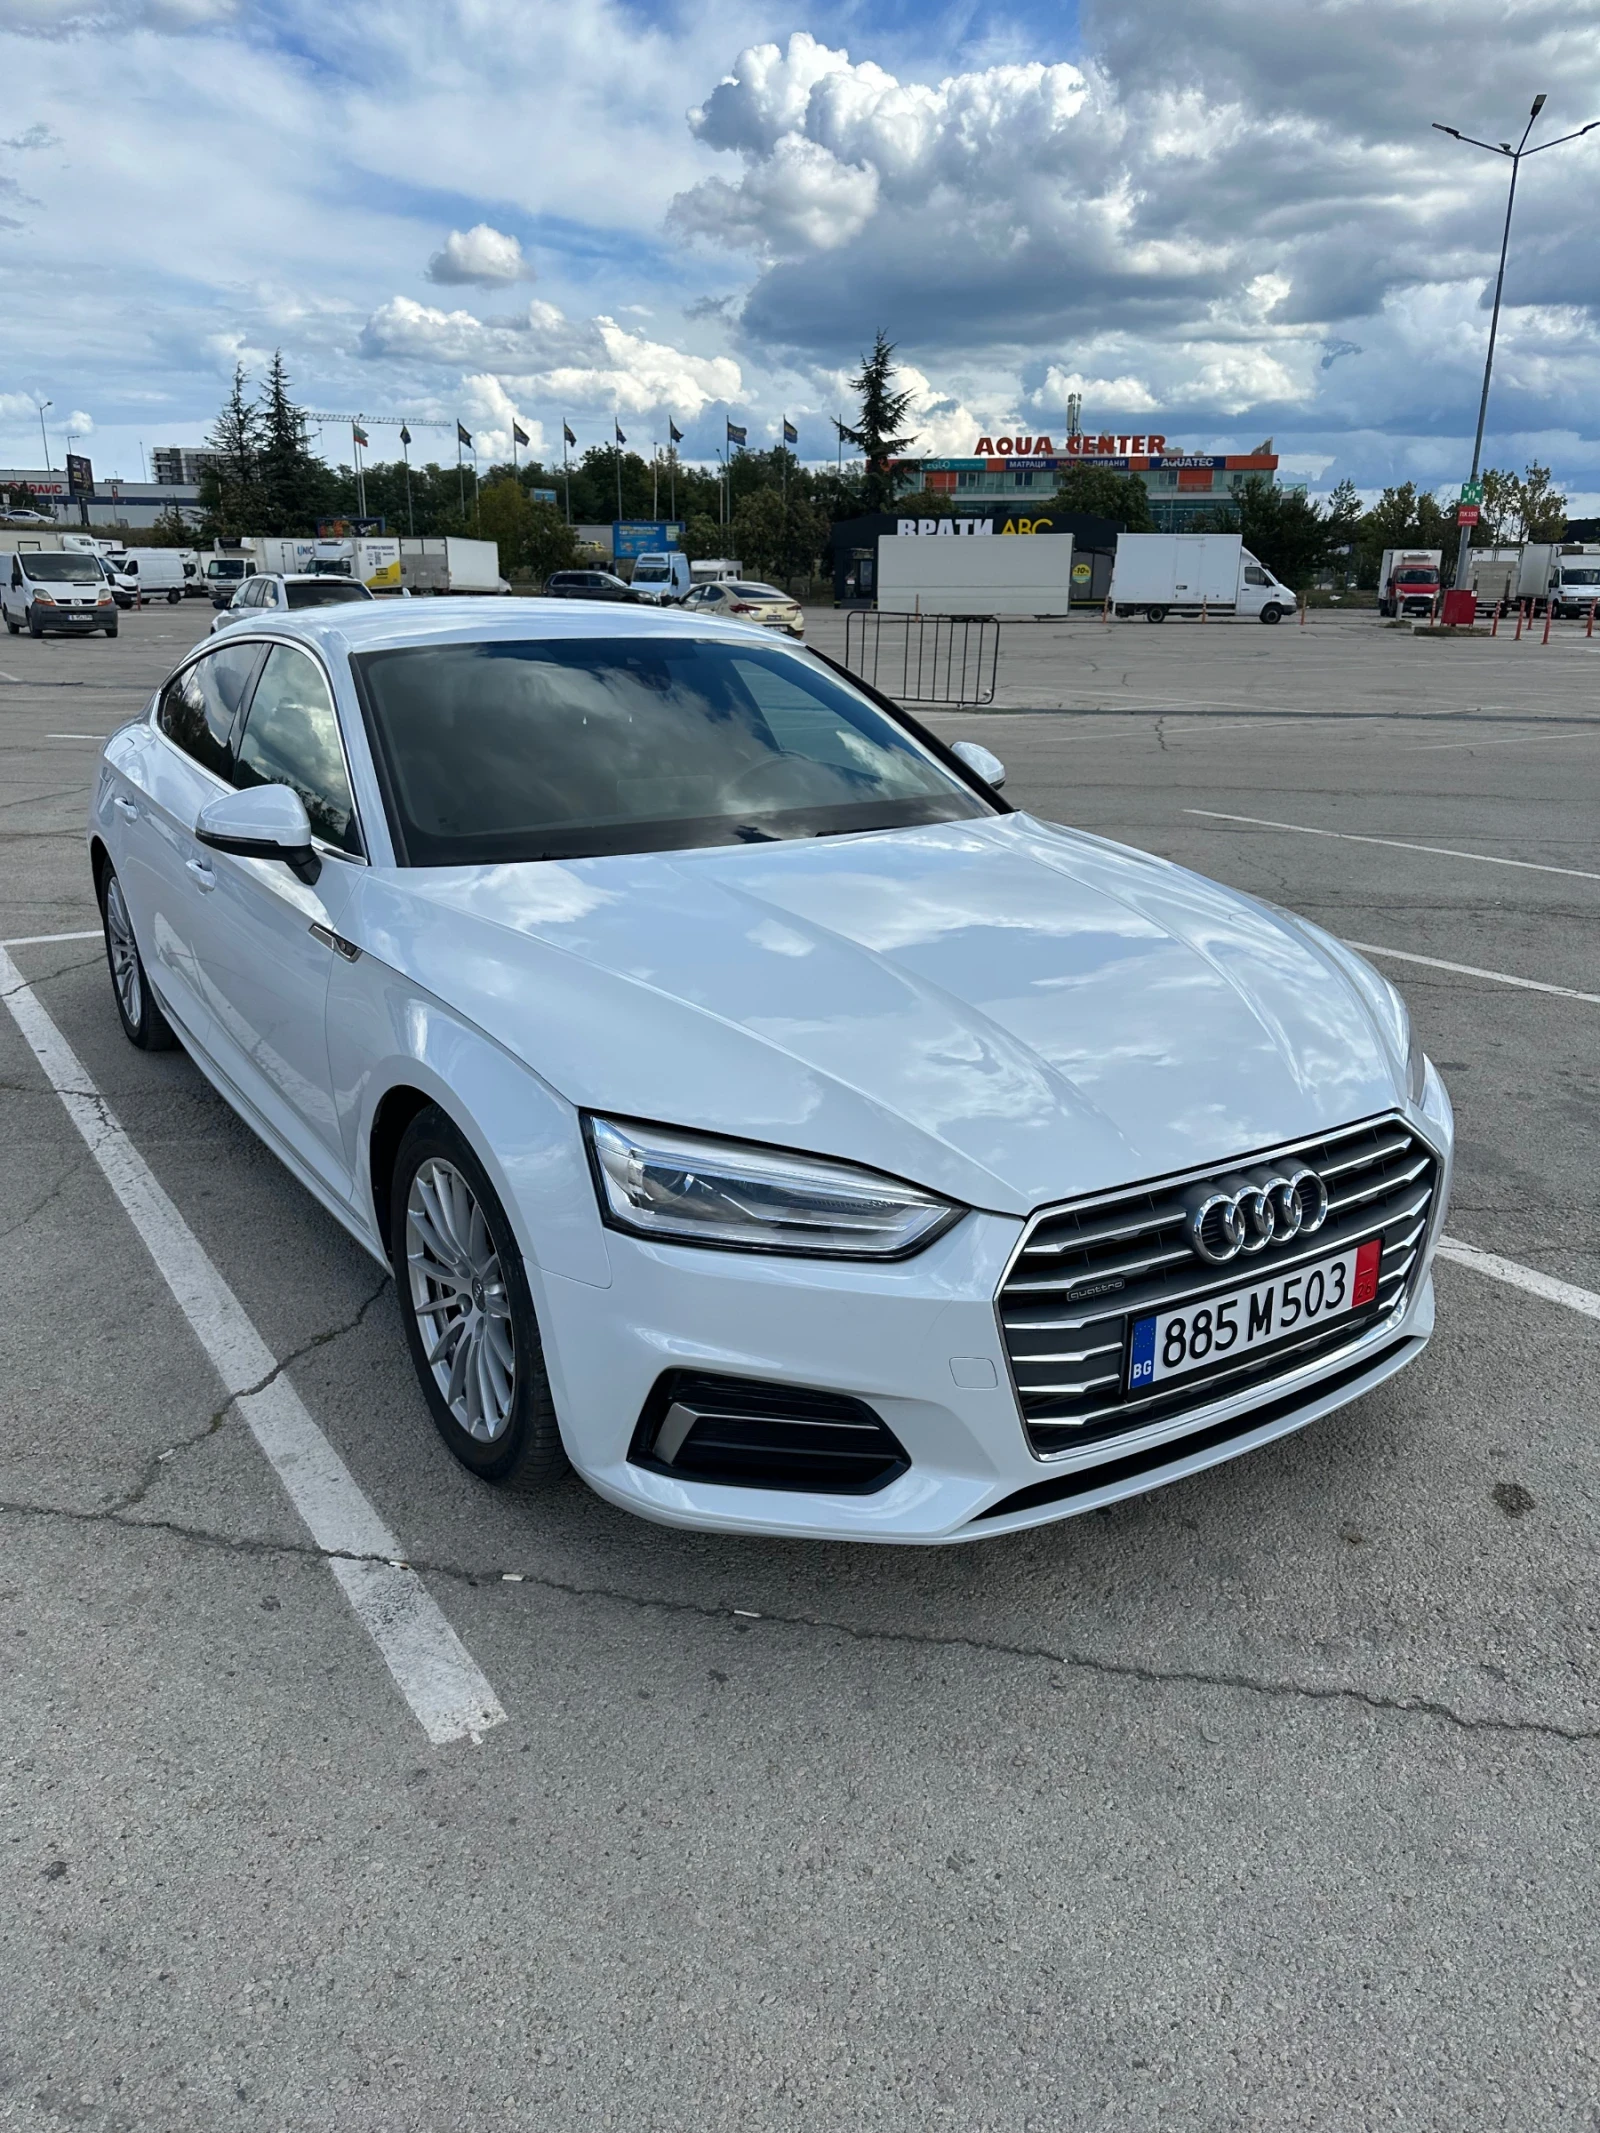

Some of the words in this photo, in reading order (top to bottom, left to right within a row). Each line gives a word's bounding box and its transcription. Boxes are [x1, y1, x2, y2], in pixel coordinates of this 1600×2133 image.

[974, 436, 1053, 456] AQUA
[1066, 435, 1166, 454] CENTER
[1009, 460, 1046, 469] МАТРАЦИ
[1160, 457, 1214, 467] AQUATEC
[897, 519, 993, 536] ВРАТИ
[1070, 1281, 1122, 1299] quattro
[1357, 1280, 1372, 1298] 26
[1133, 1360, 1152, 1379] BG
[1162, 1298, 1238, 1368] 885
[1247, 1286, 1275, 1342] M
[1280, 1261, 1346, 1328] 503
